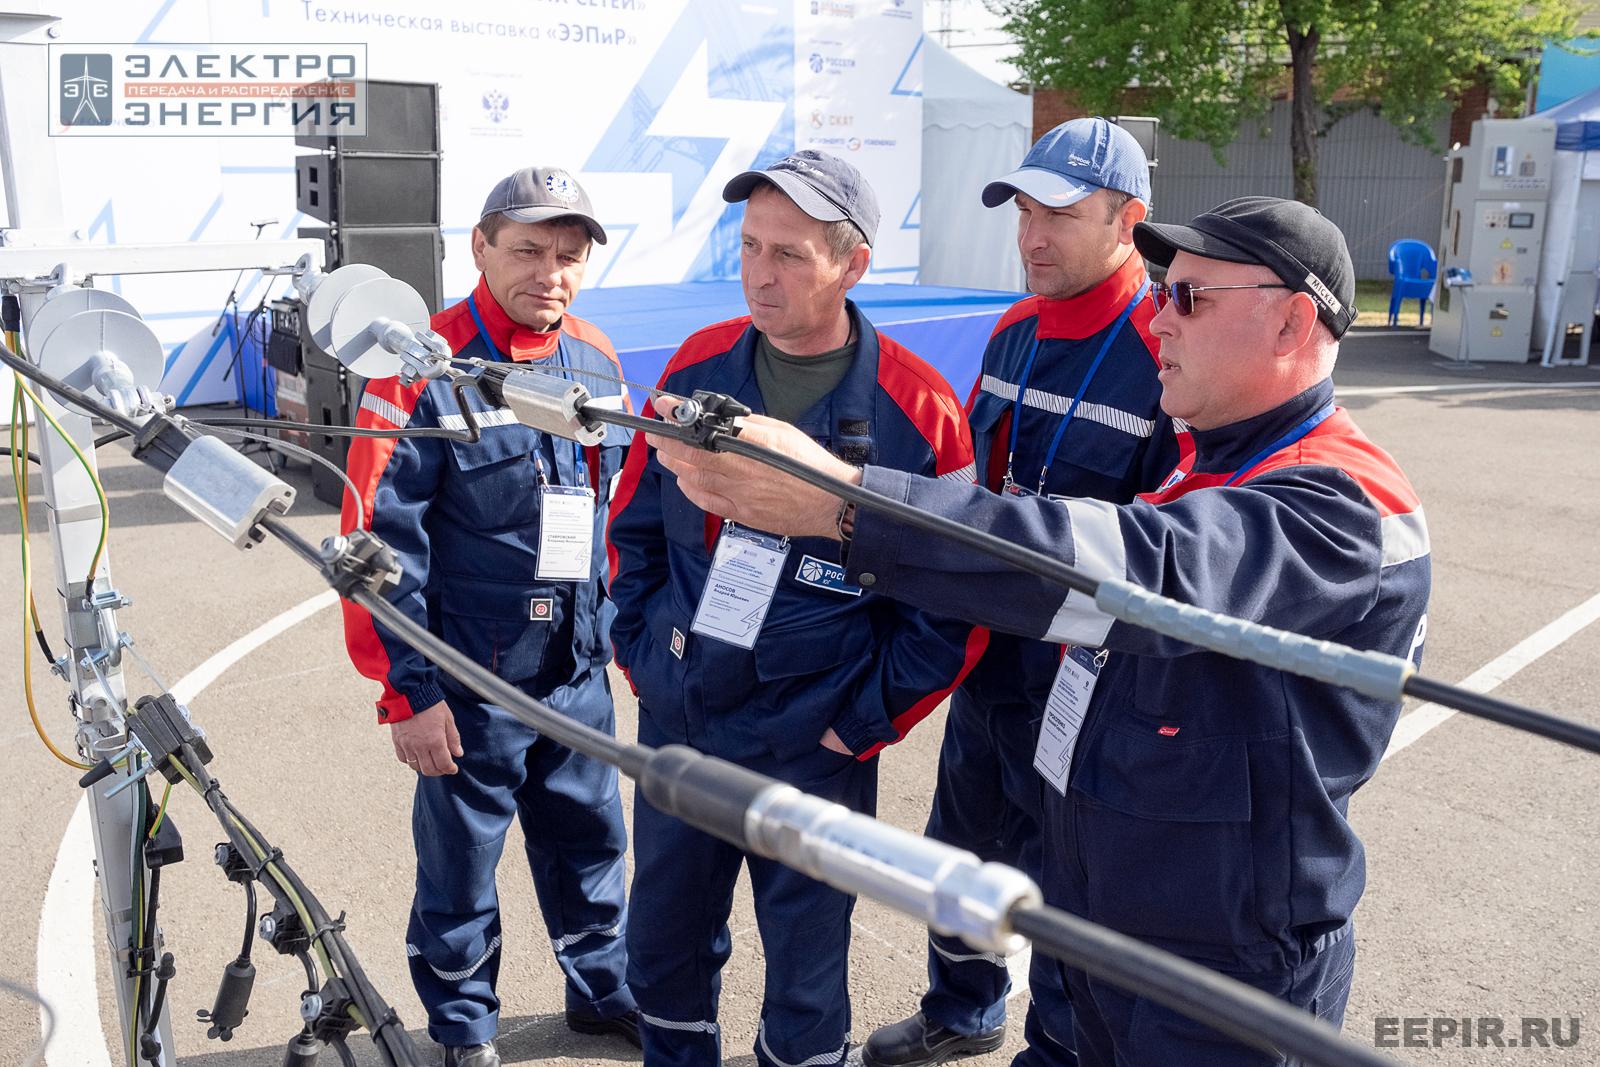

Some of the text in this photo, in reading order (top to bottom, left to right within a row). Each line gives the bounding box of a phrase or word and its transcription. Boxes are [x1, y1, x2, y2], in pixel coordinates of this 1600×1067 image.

[303, 0, 637, 45] Техническая выставка «ЭЭПиР»
